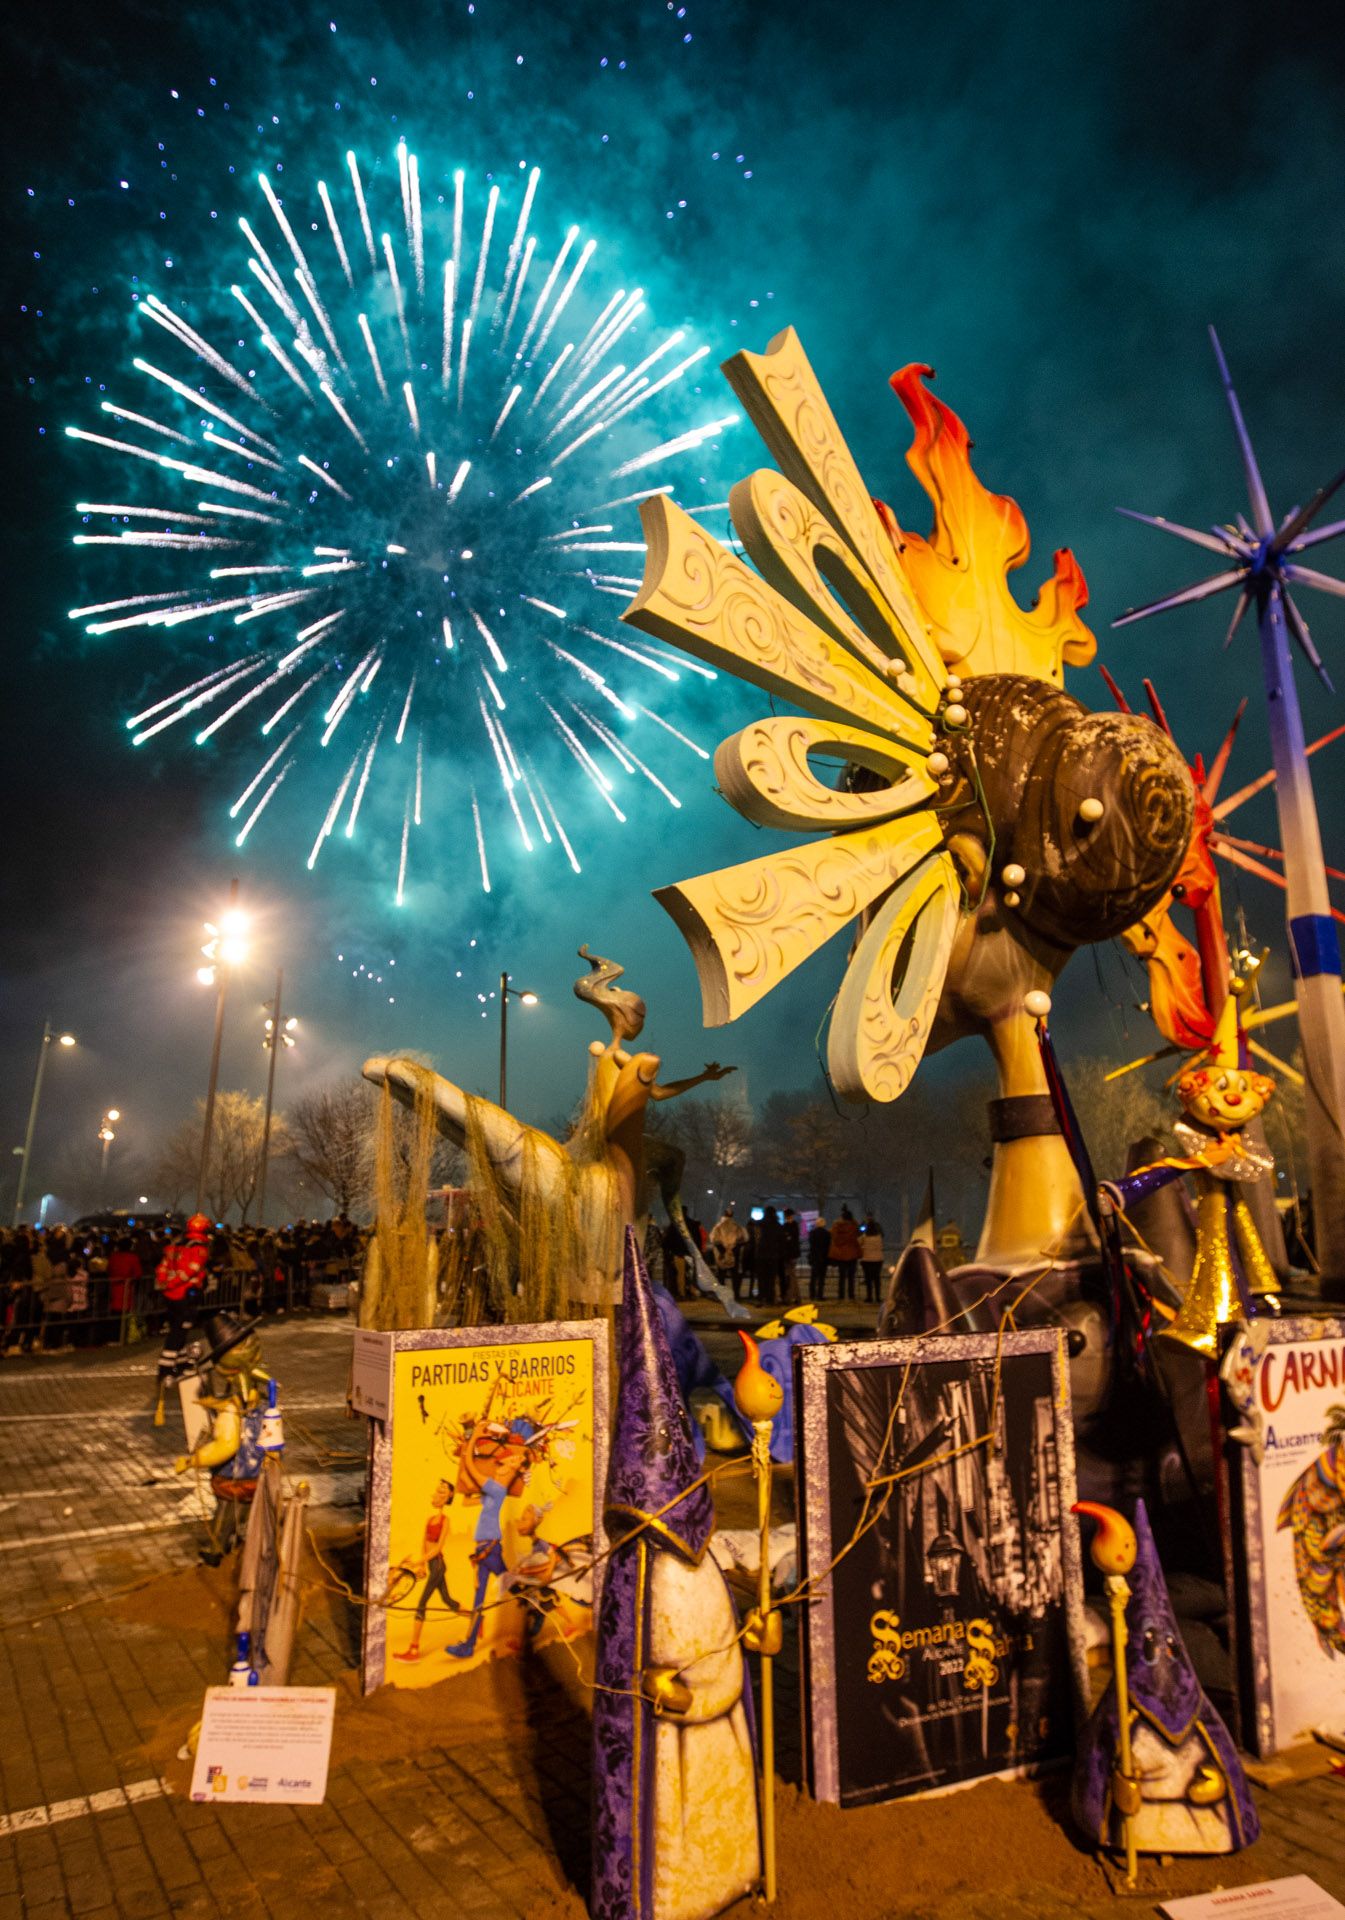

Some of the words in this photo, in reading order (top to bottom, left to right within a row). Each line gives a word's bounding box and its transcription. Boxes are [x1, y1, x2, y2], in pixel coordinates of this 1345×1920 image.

[473, 1350, 506, 1360] FIESTAS
[509, 1350, 520, 1358] EN
[412, 1361, 489, 1387] PARTIDAS
[495, 1360, 504, 1378] Y
[510, 1355, 575, 1379] BARRIOS
[1261, 1346, 1345, 1413] CARN
[495, 1379, 555, 1399] ALICANTE
[867, 1609, 965, 1684] Semana
[939, 1658, 964, 1676] 2022
[278, 1778, 311, 1788] Alicante
